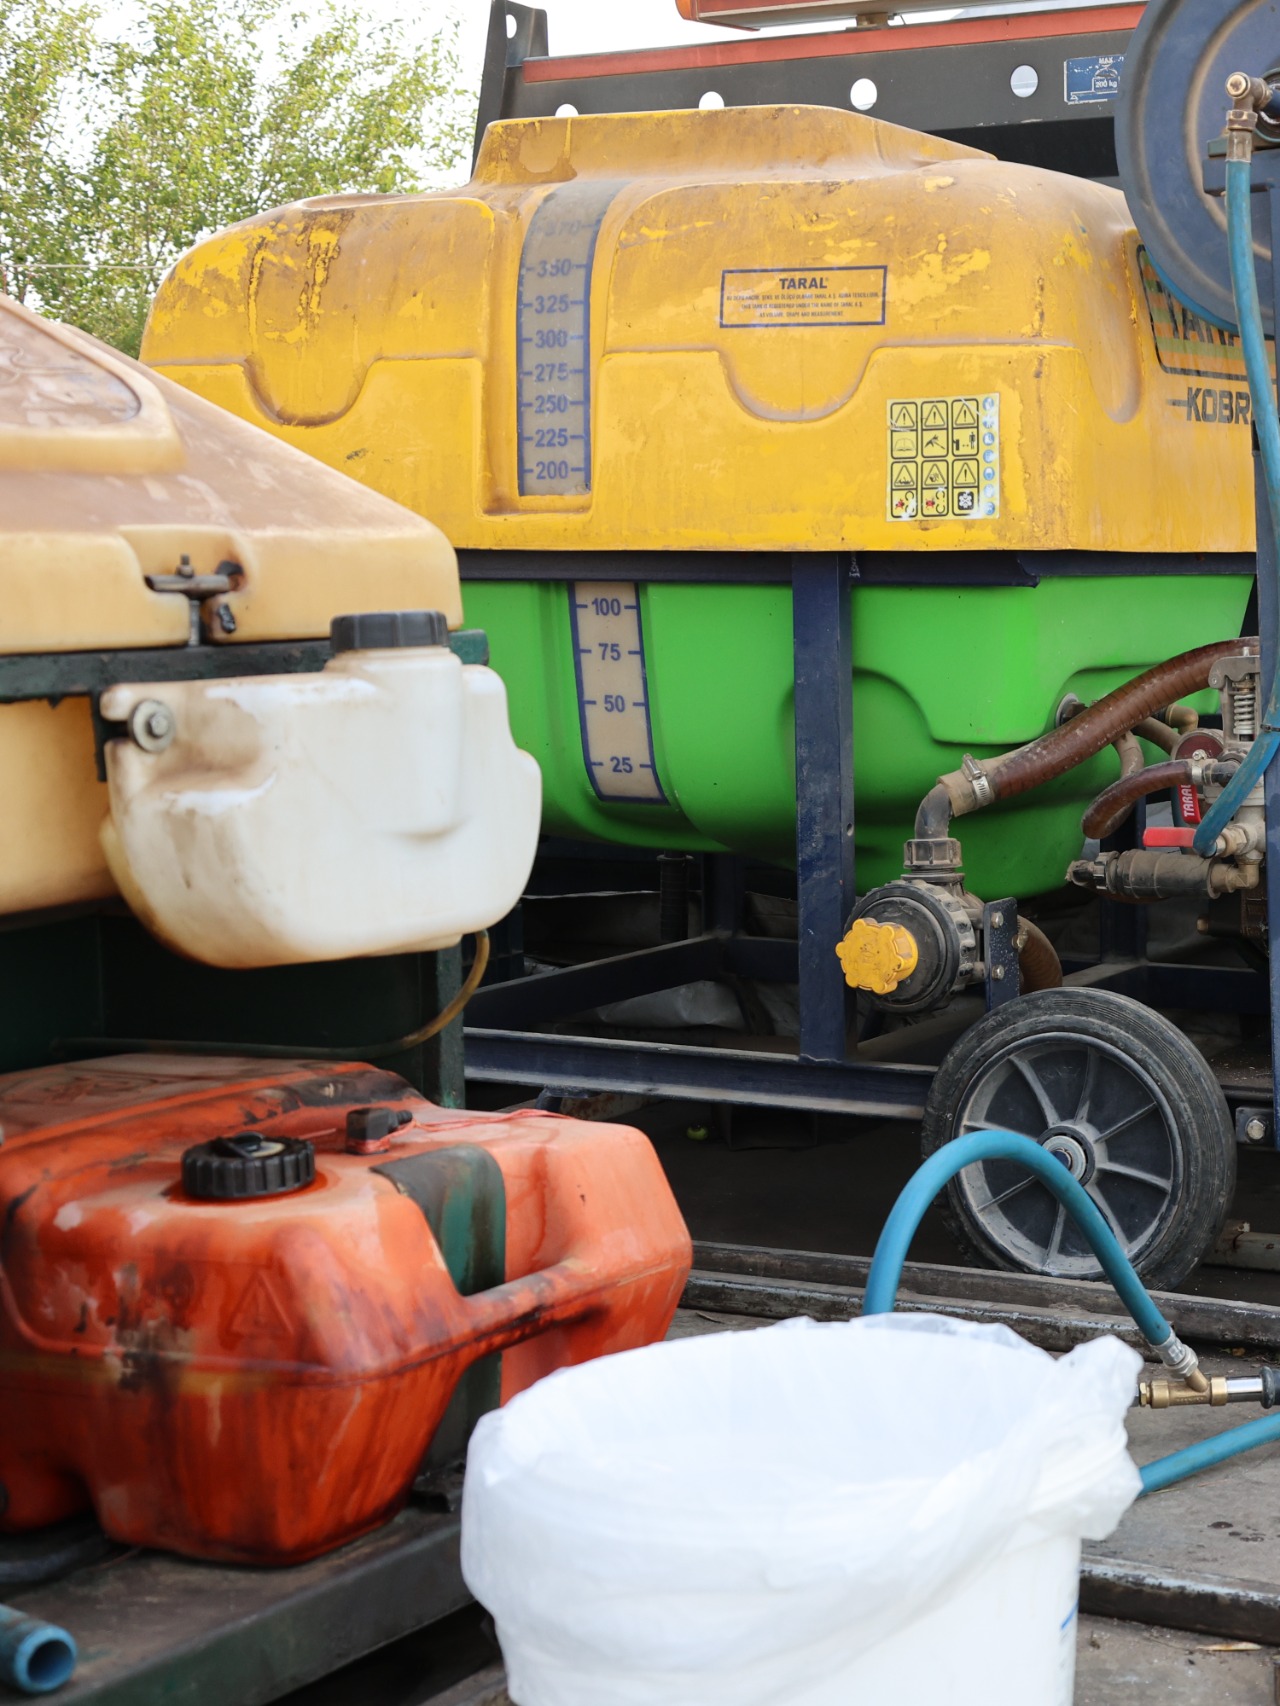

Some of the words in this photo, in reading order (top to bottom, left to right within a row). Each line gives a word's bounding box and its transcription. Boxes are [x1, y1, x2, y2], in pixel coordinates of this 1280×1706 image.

[1098, 56, 1114, 64] MAX
[1095, 80, 1107, 88] 200
[1108, 80, 1118, 88] kg
[536, 258, 572, 278] 350
[779, 276, 828, 289] TARAL
[534, 294, 570, 315] 325
[534, 328, 569, 349] 300
[534, 362, 569, 383] 275
[534, 394, 569, 414] 250
[534, 428, 569, 448] 225
[535, 460, 569, 480] 200
[591, 598, 622, 617] 100
[598, 642, 622, 661] 75
[603, 694, 626, 713] 50
[609, 756, 634, 774] 25
